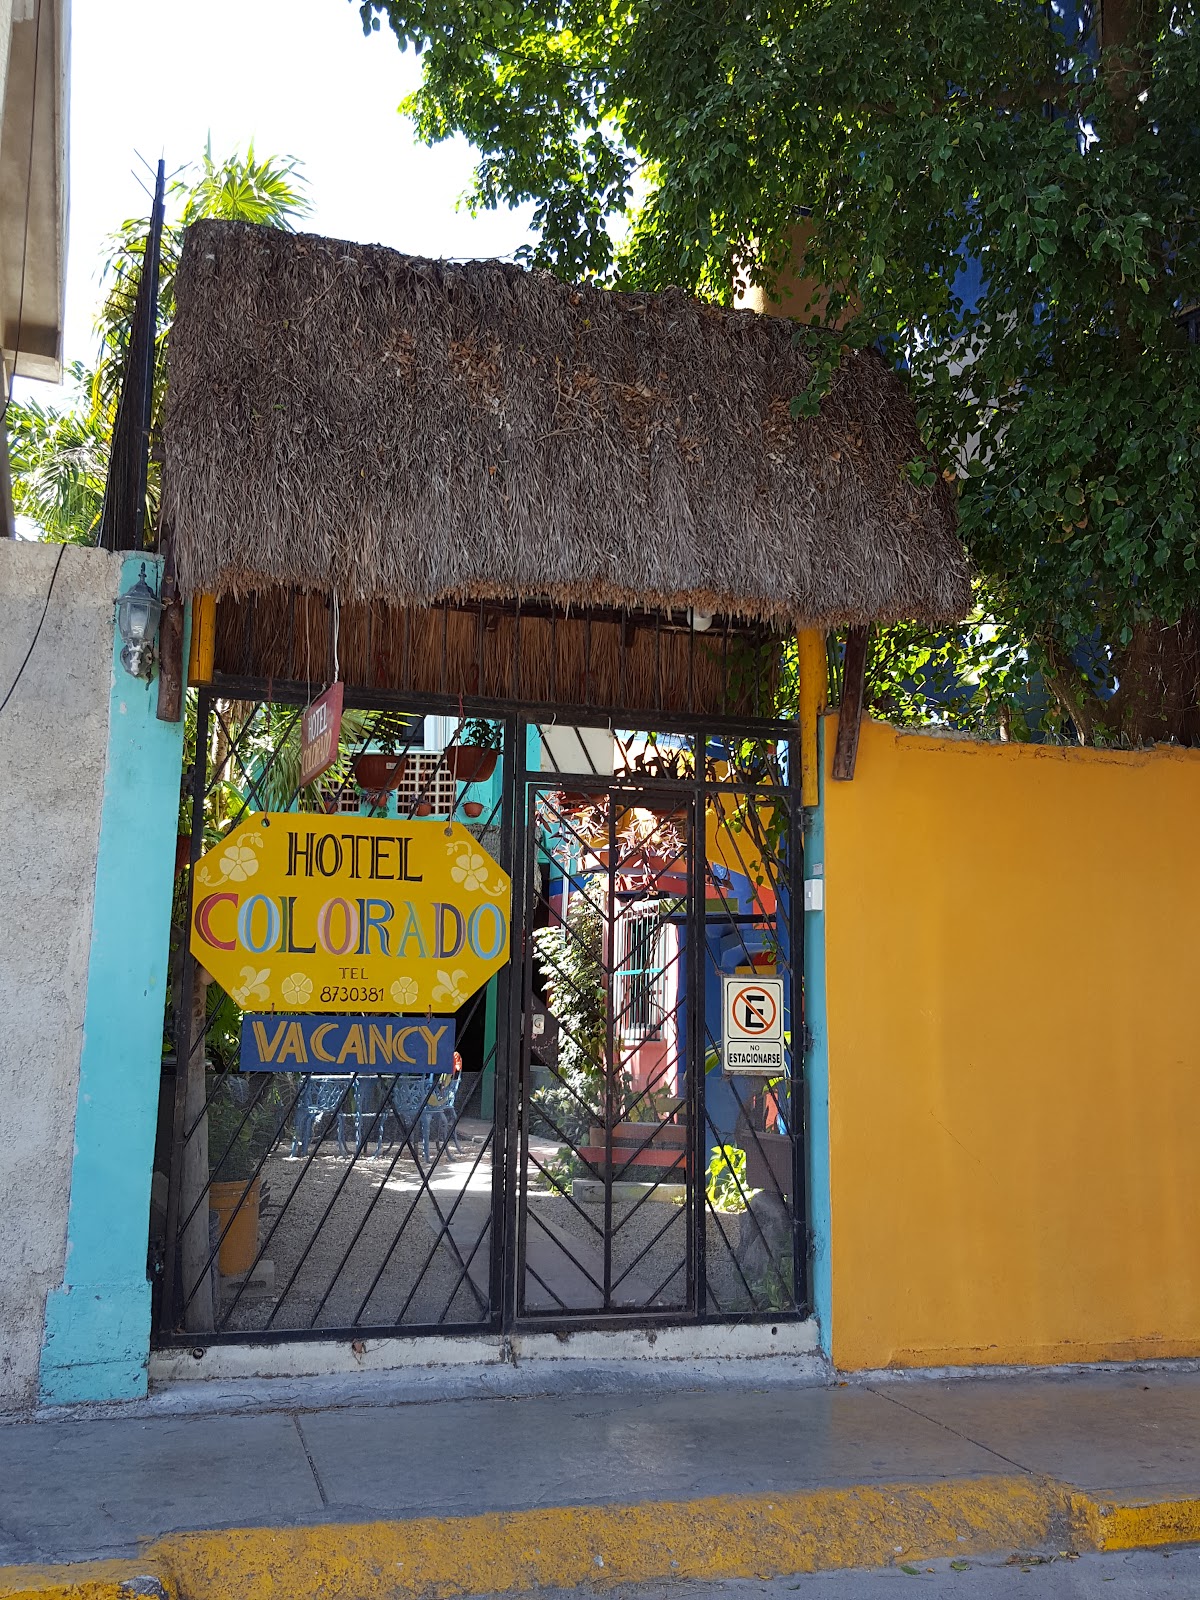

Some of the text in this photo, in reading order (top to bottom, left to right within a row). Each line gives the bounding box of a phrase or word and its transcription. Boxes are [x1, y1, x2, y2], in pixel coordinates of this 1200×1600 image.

[307, 702, 328, 745] HOTEL
[285, 832, 423, 882] HOTEL
[194, 891, 507, 960] COLORADO
[338, 967, 369, 980] TEL
[320, 986, 385, 1003] 8730381
[745, 994, 765, 1028] E
[252, 1020, 448, 1066] VACANCY
[729, 1053, 780, 1064] ESTACIONARSE
